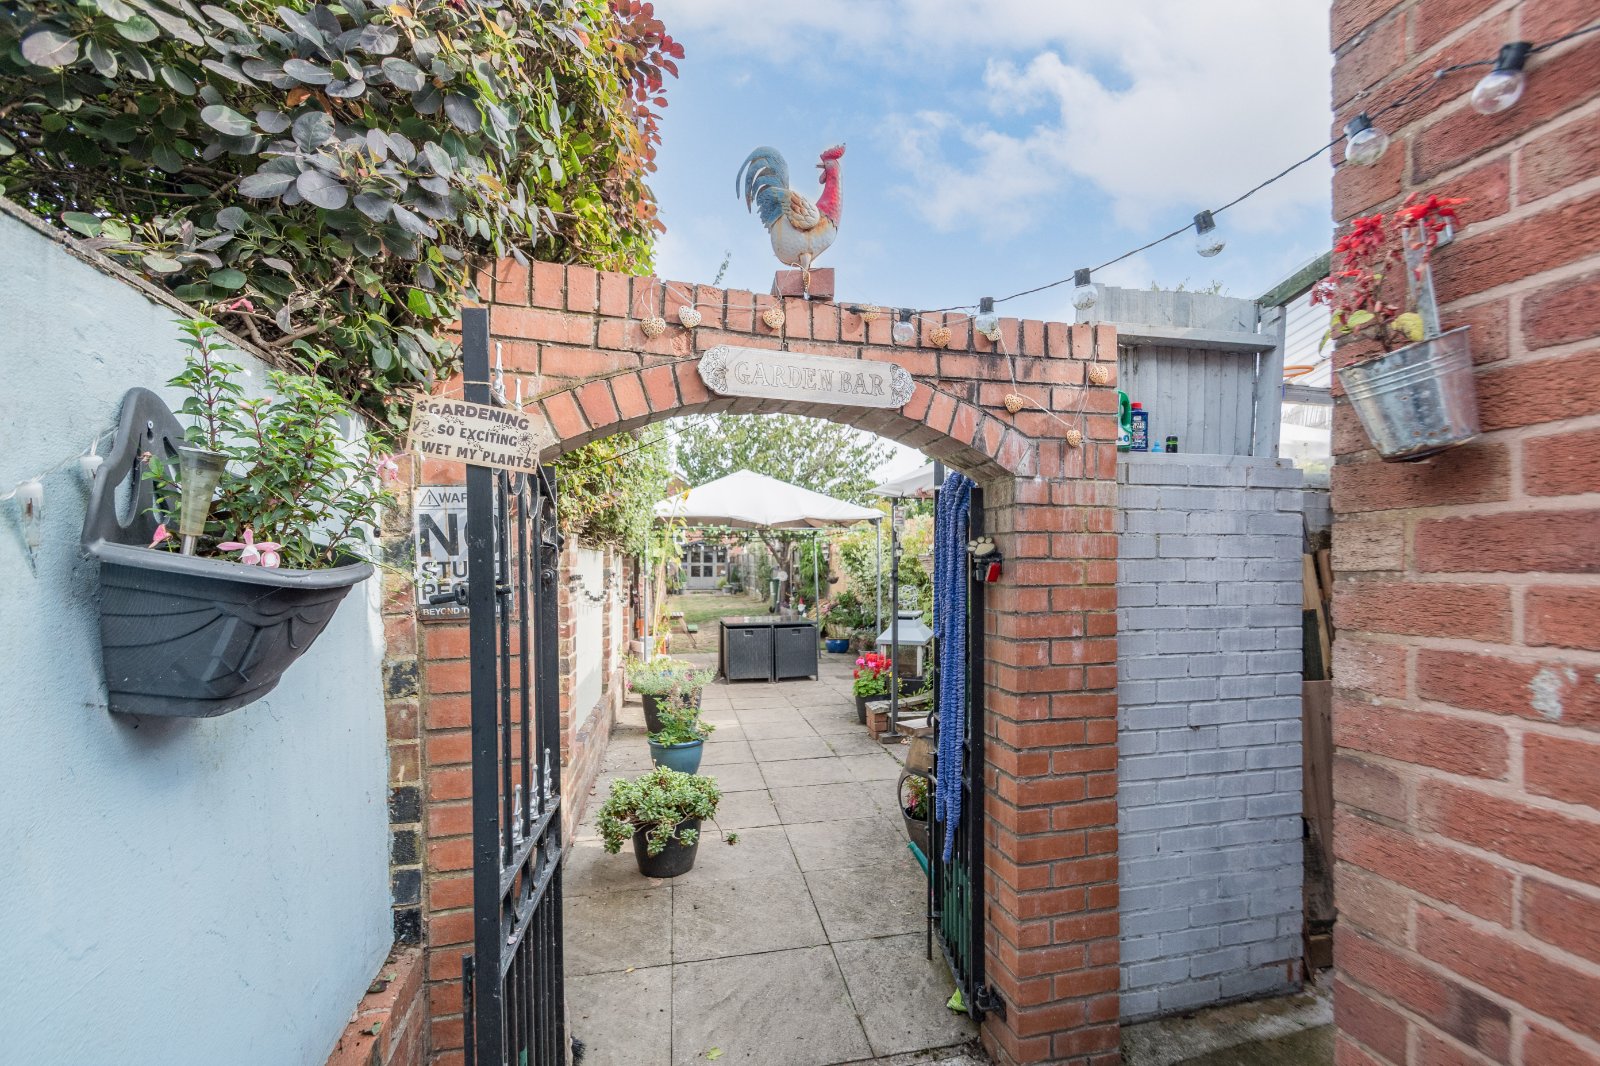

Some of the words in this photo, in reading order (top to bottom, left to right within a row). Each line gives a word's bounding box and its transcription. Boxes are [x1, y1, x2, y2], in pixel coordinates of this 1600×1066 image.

[734, 361, 834, 392] GARDEN
[838, 370, 885, 397] BAR
[428, 402, 530, 431] GARDENING
[437, 424, 455, 437] SO
[460, 427, 518, 447] EXCITING
[422, 441, 452, 456] WET
[456, 446, 478, 460] MY
[482, 451, 537, 470] PLANTS!
[422, 607, 460, 616] BEYOND
